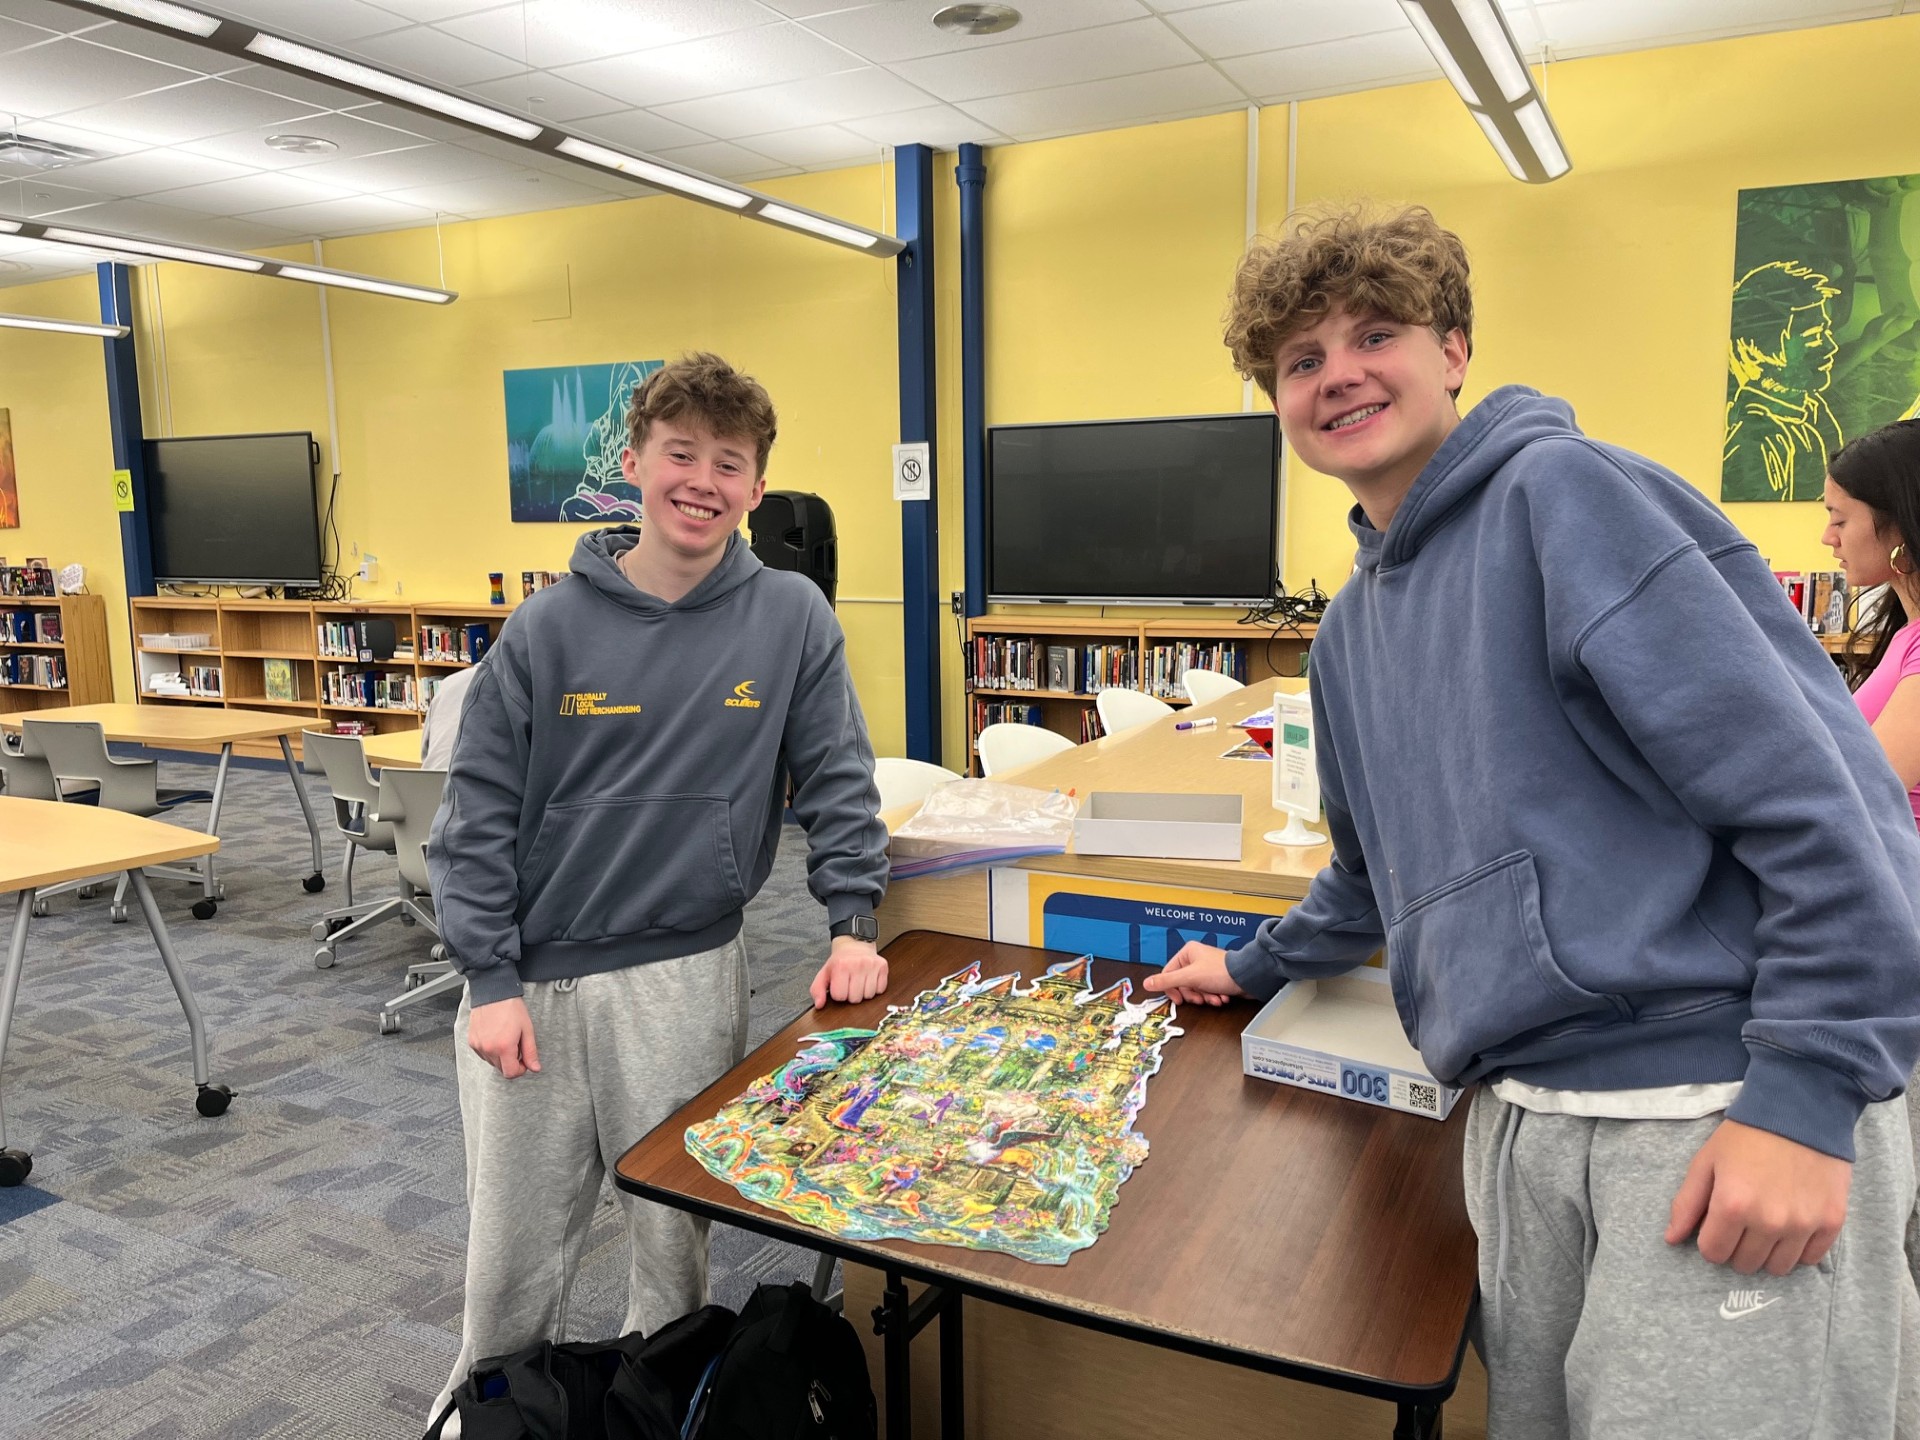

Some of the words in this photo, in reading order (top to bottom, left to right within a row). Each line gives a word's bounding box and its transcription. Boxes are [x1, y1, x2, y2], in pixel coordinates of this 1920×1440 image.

[576, 692, 607, 701] GLOBALLY
[576, 700, 595, 708] LOCAL
[576, 707, 589, 716] NOT
[589, 705, 642, 715] MERCHANDISING
[1144, 906, 1196, 921] WELCOME
[1199, 912, 1213, 923] TO
[1216, 914, 1246, 927] YOUR
[1253, 1062, 1295, 1081] PIECES
[1307, 1072, 1337, 1089] BITS
[1342, 1070, 1387, 1102] 300
[1727, 1290, 1765, 1308] NIKE
